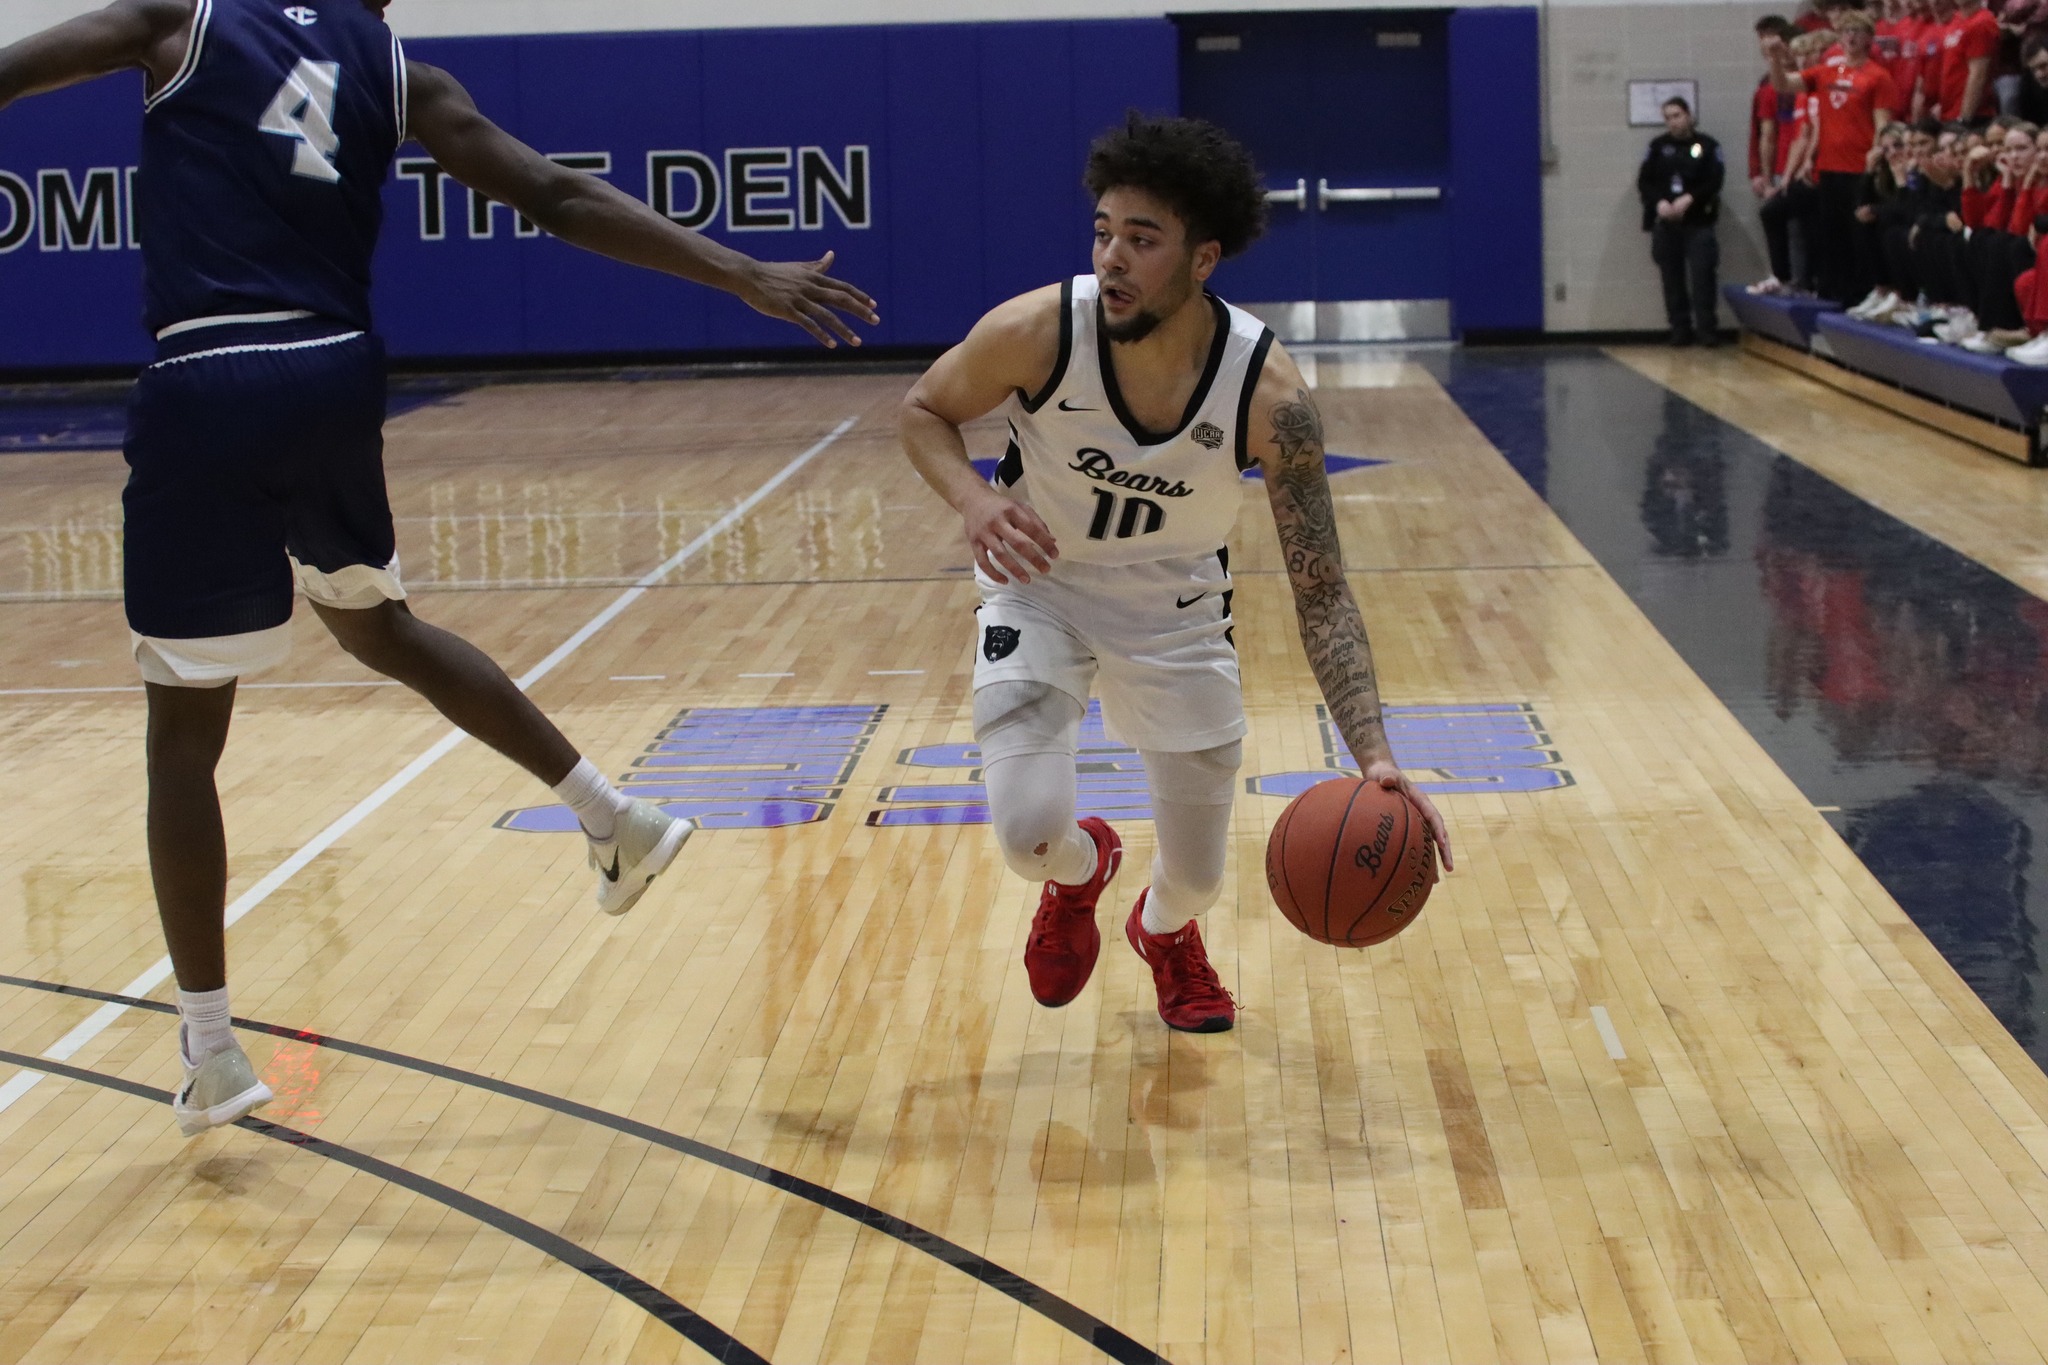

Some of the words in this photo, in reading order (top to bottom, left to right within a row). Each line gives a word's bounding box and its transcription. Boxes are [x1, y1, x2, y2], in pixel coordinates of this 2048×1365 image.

[258, 57, 341, 184] 4
[647, 145, 871, 232] DEN
[1068, 447, 1194, 498] Bears
[1086, 486, 1167, 541] 10
[1355, 812, 1395, 879] Bears
